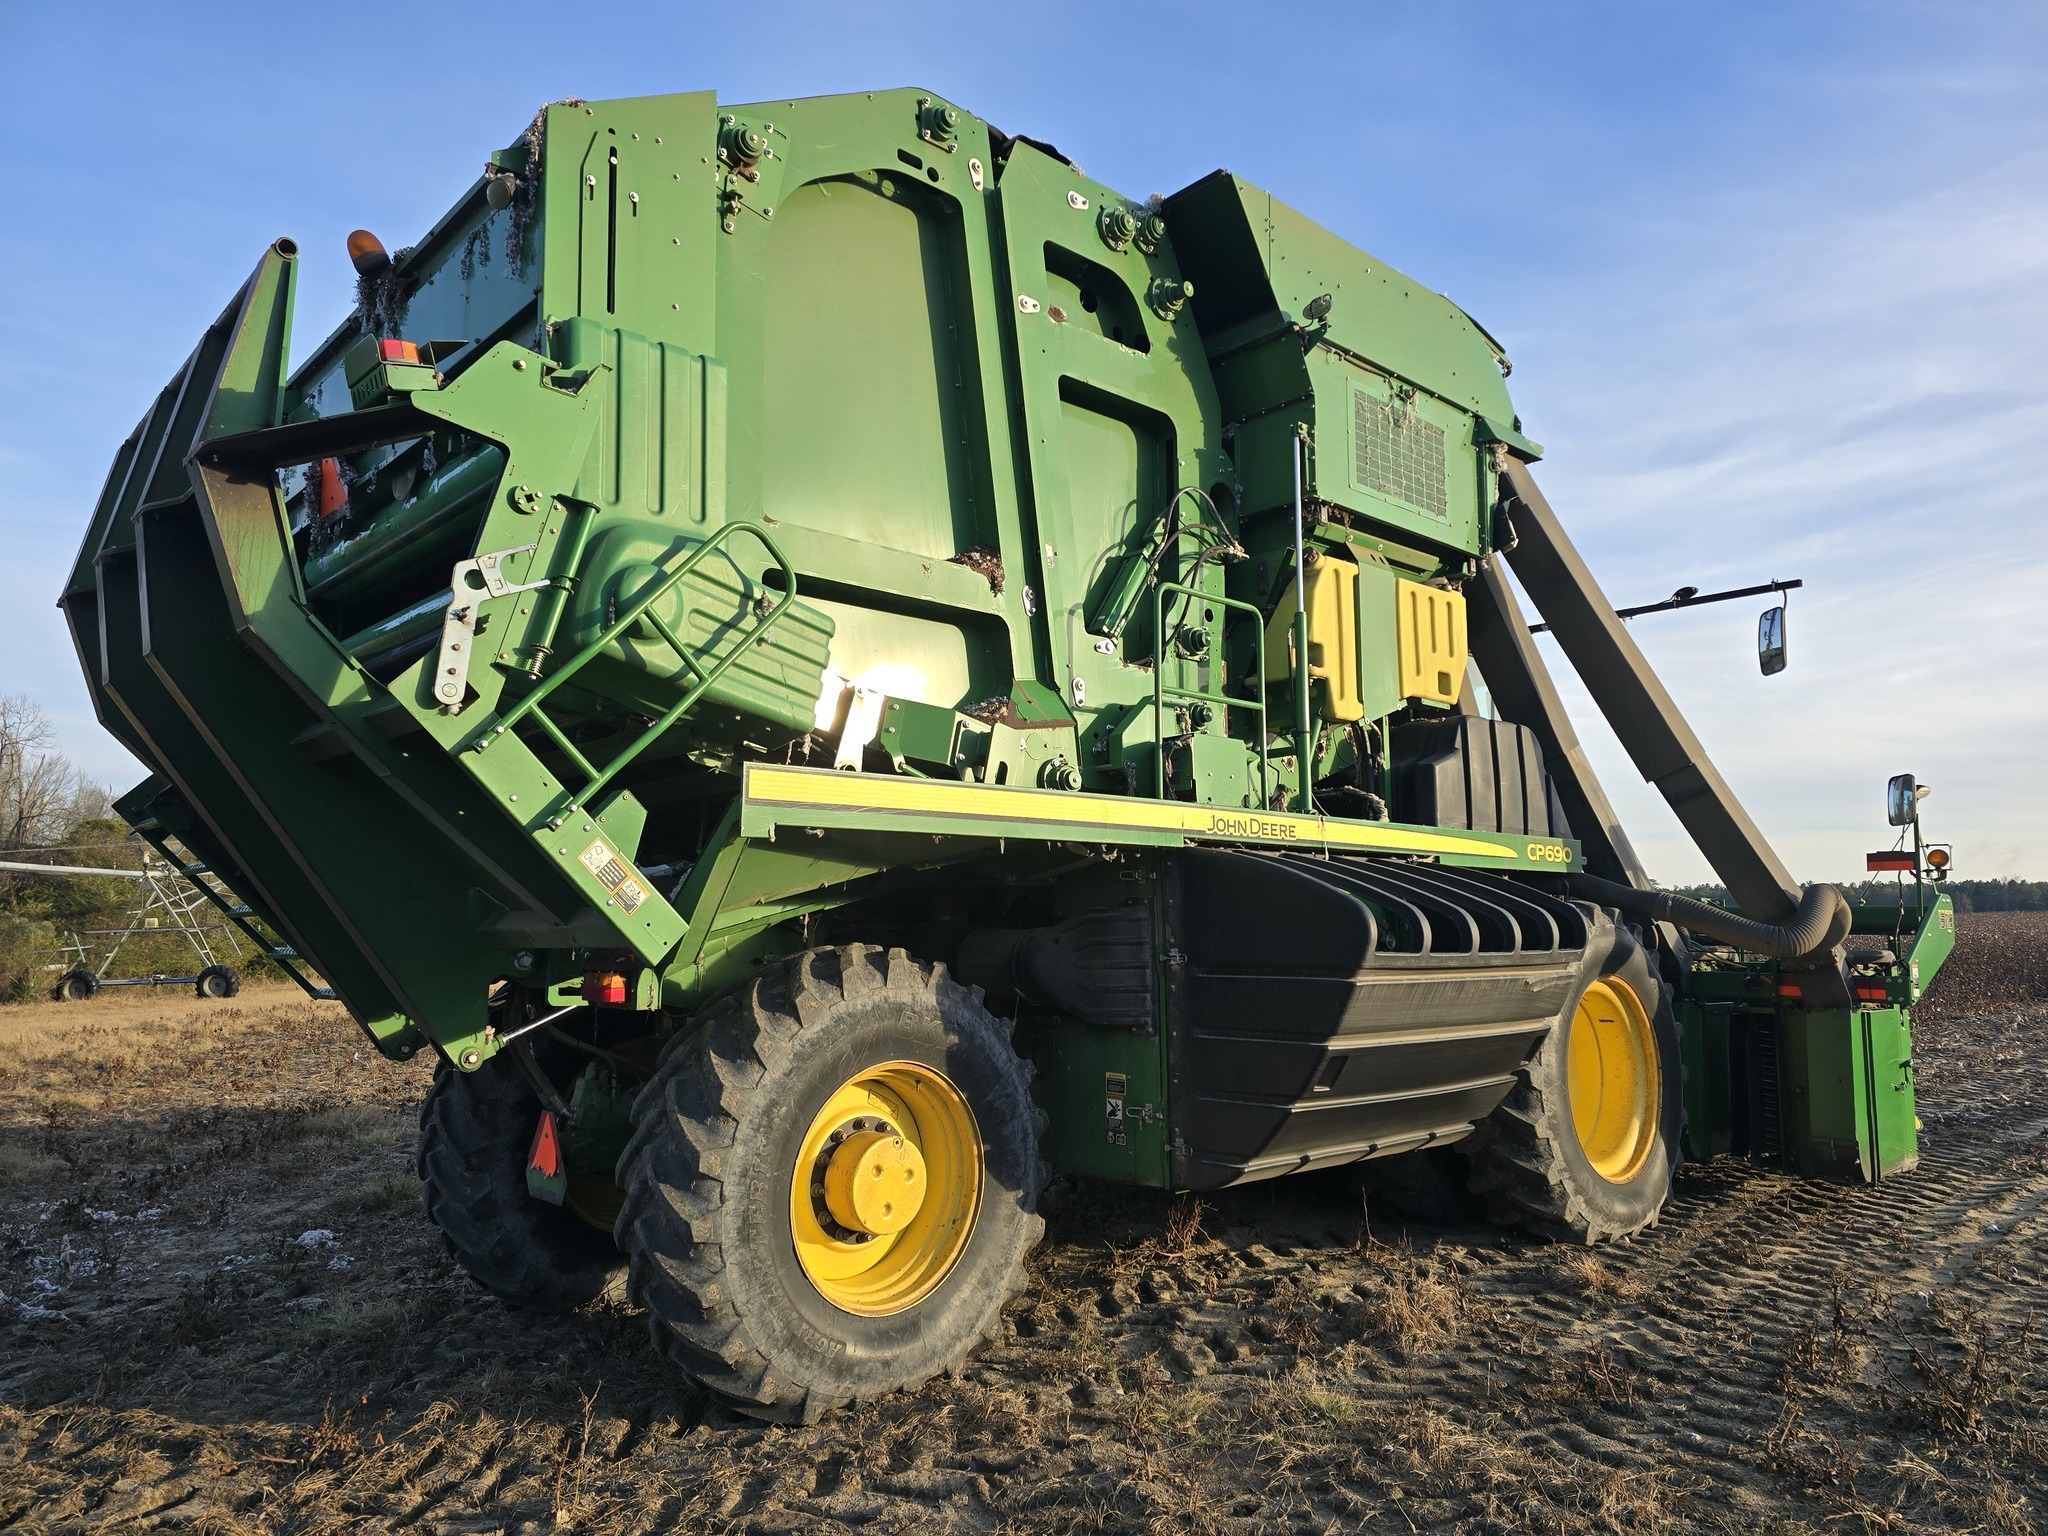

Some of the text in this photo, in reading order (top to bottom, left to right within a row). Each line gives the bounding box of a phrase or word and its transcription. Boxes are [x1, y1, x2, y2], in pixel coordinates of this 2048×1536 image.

[1527, 843, 1572, 864] CP690
[897, 1010, 955, 1043] BK
[794, 1322, 842, 1358] AGRI
